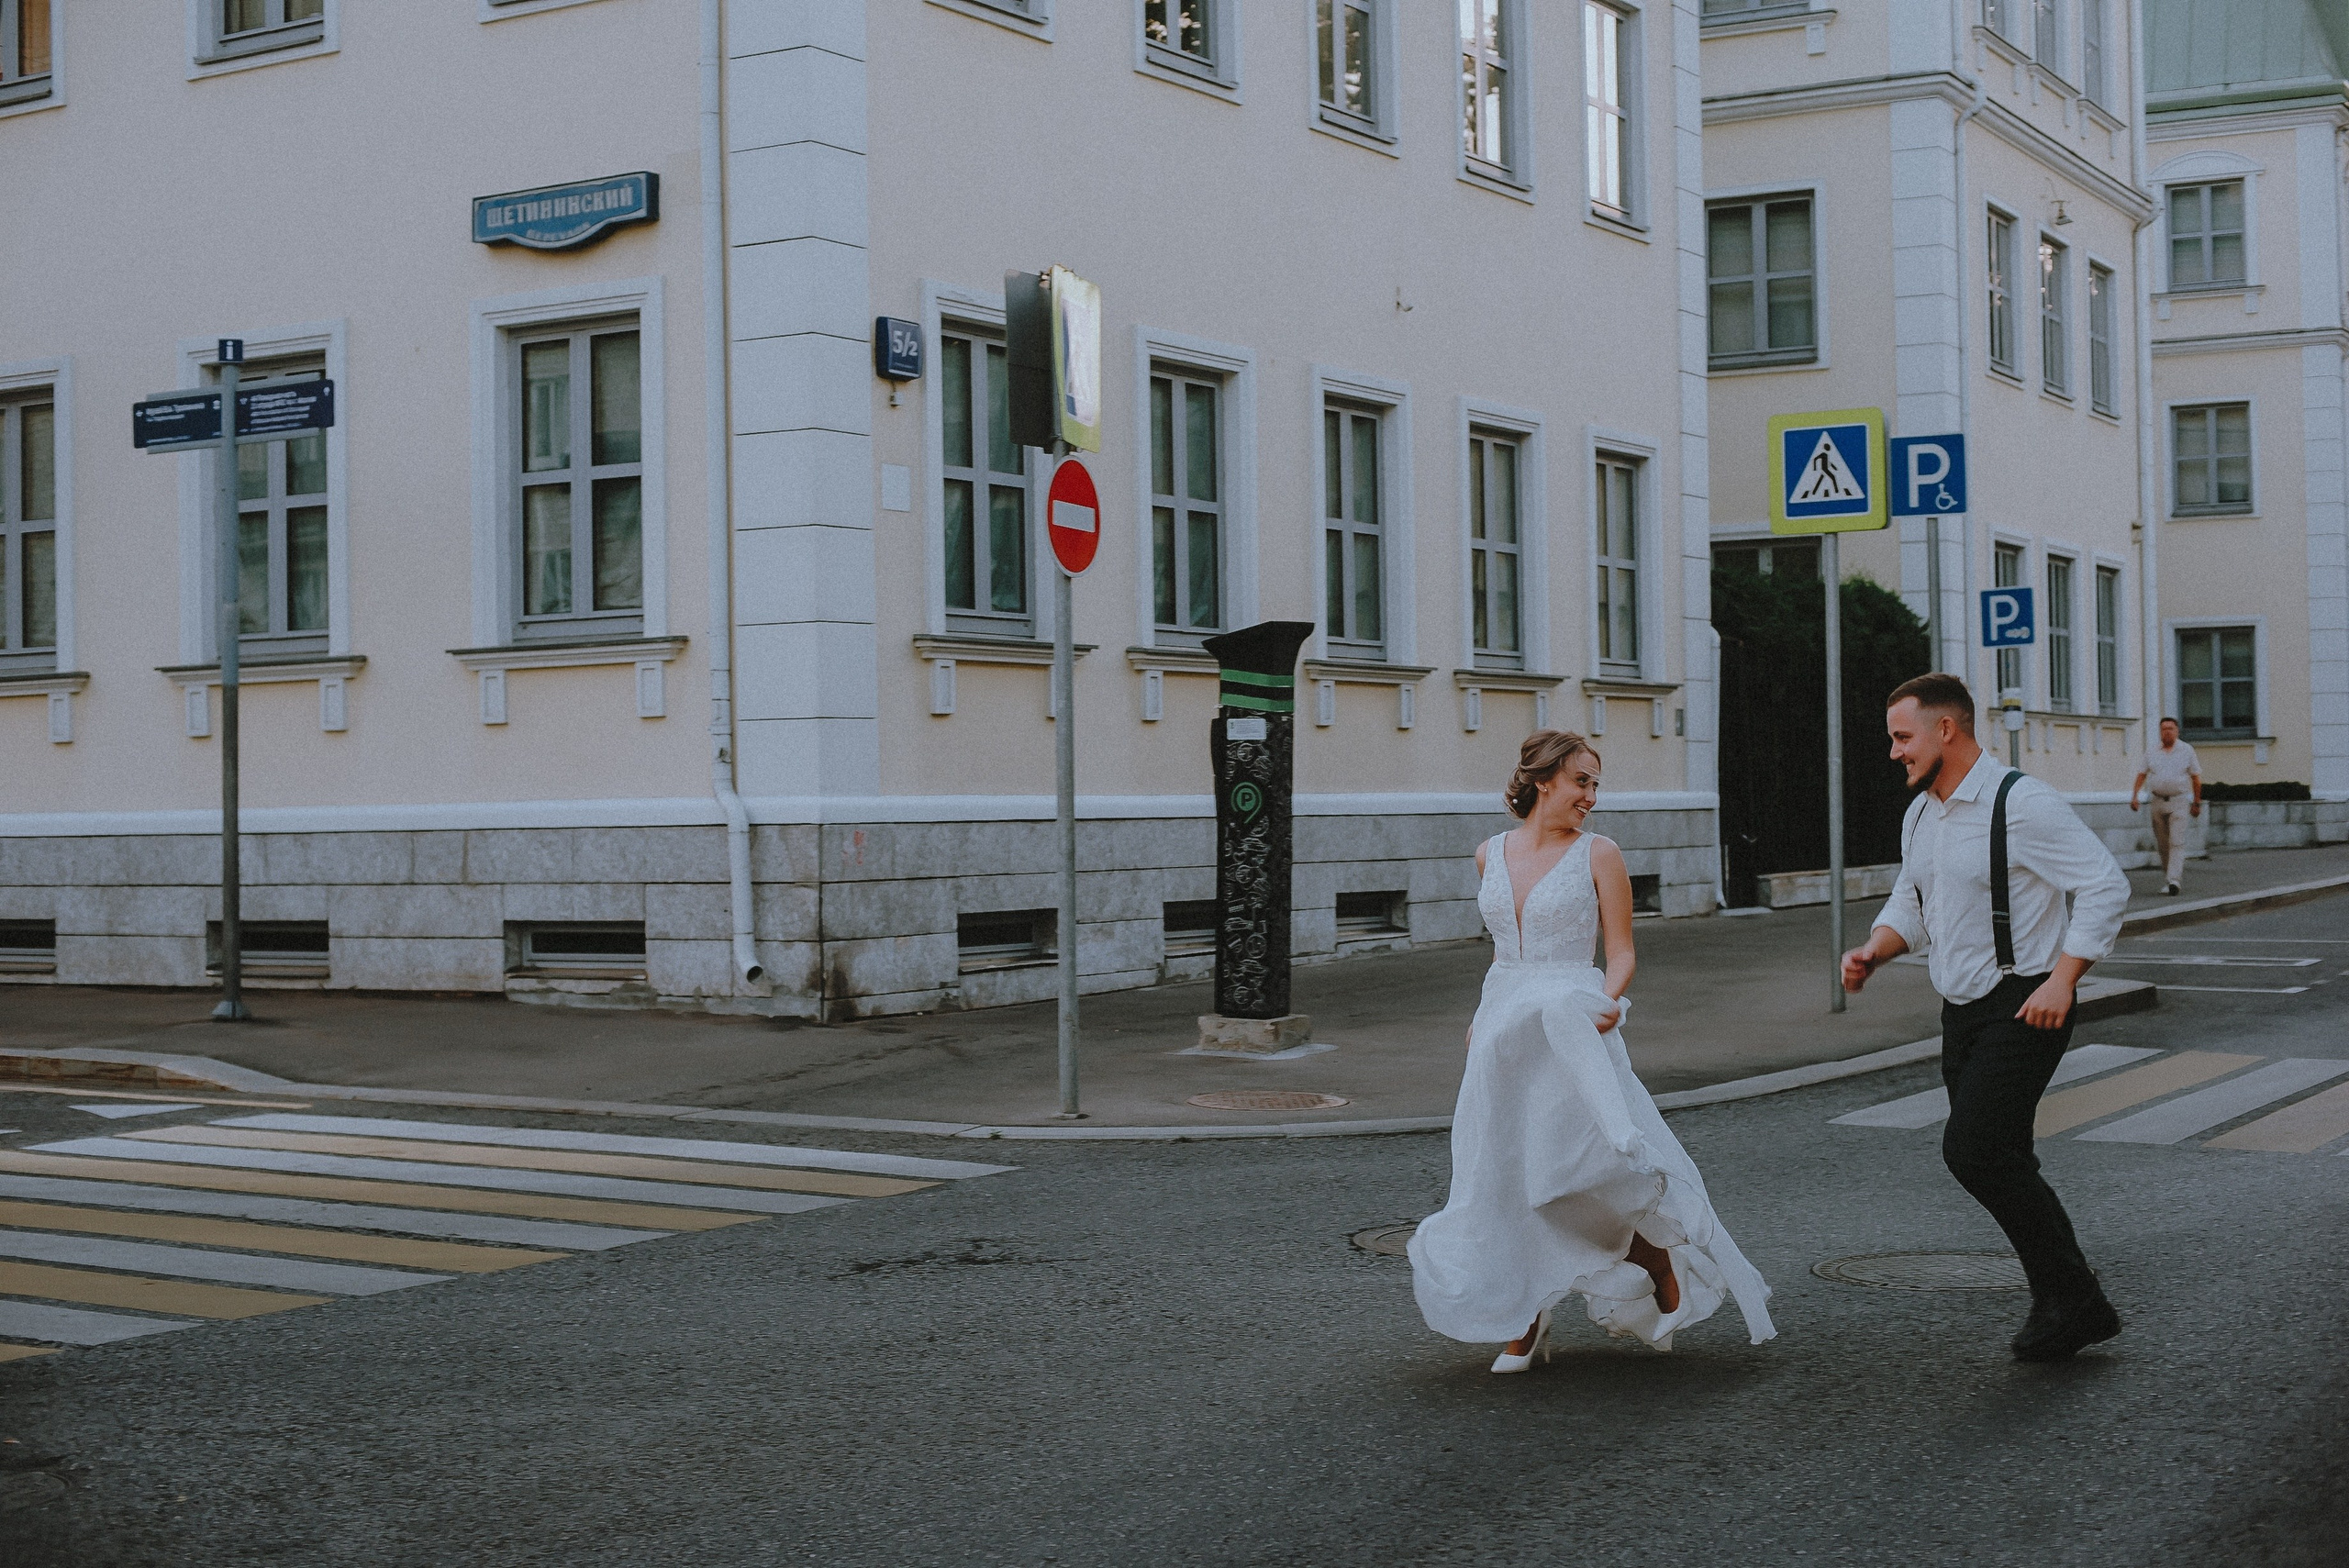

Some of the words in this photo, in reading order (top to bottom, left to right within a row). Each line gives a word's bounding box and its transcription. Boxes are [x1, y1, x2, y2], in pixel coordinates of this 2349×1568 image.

[226, 340, 234, 361] i
[892, 330, 918, 358] 5/2
[1908, 443, 1951, 508] P
[1989, 595, 2020, 641] P
[1241, 792, 1255, 807] P
